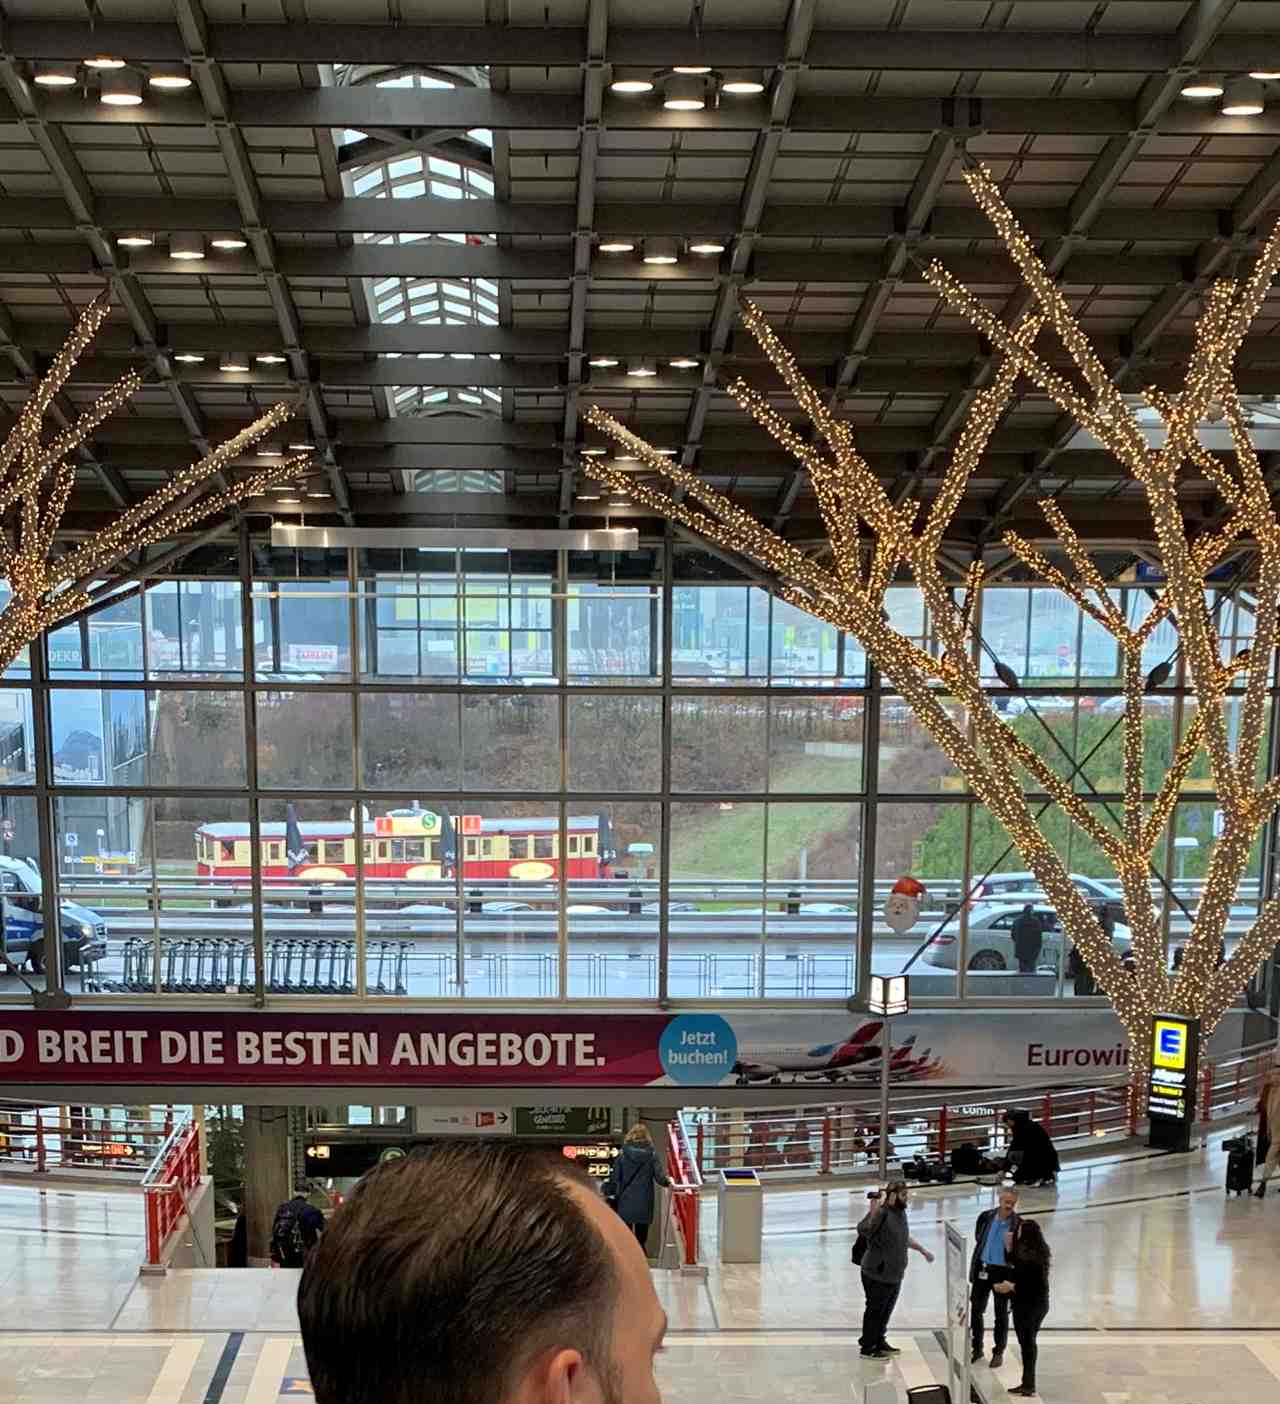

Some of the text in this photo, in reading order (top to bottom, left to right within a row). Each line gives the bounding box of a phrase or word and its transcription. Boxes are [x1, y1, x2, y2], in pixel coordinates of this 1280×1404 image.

[37, 1029, 148, 1064] BREIT
[160, 1030, 224, 1065] DIE
[236, 1031, 381, 1066] BESTEN
[390, 1032, 607, 1067] ANGEBOTE.
[680, 1030, 717, 1046] Jetzt
[1160, 1028, 1182, 1055] E
[668, 1048, 729, 1065] buchen!
